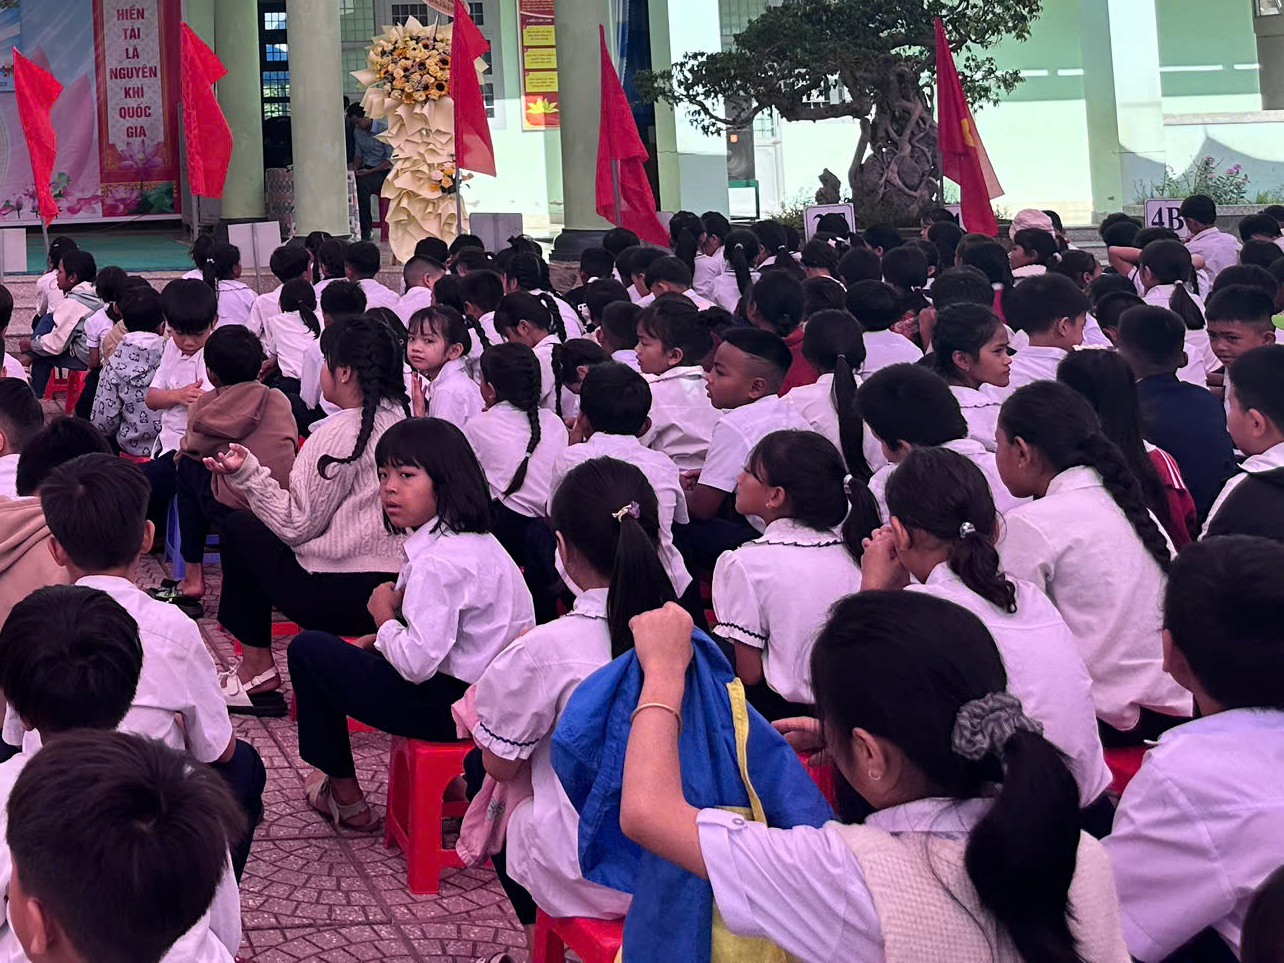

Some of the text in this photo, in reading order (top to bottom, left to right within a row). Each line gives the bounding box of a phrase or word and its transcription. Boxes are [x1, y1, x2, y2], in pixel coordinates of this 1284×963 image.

[125, 45, 140, 60] LÀ
[109, 64, 158, 80] NGUYÊN
[124, 83, 144, 99] KHÍ
[126, 126, 147, 138] GIA
[1151, 206, 1185, 231] 4B
